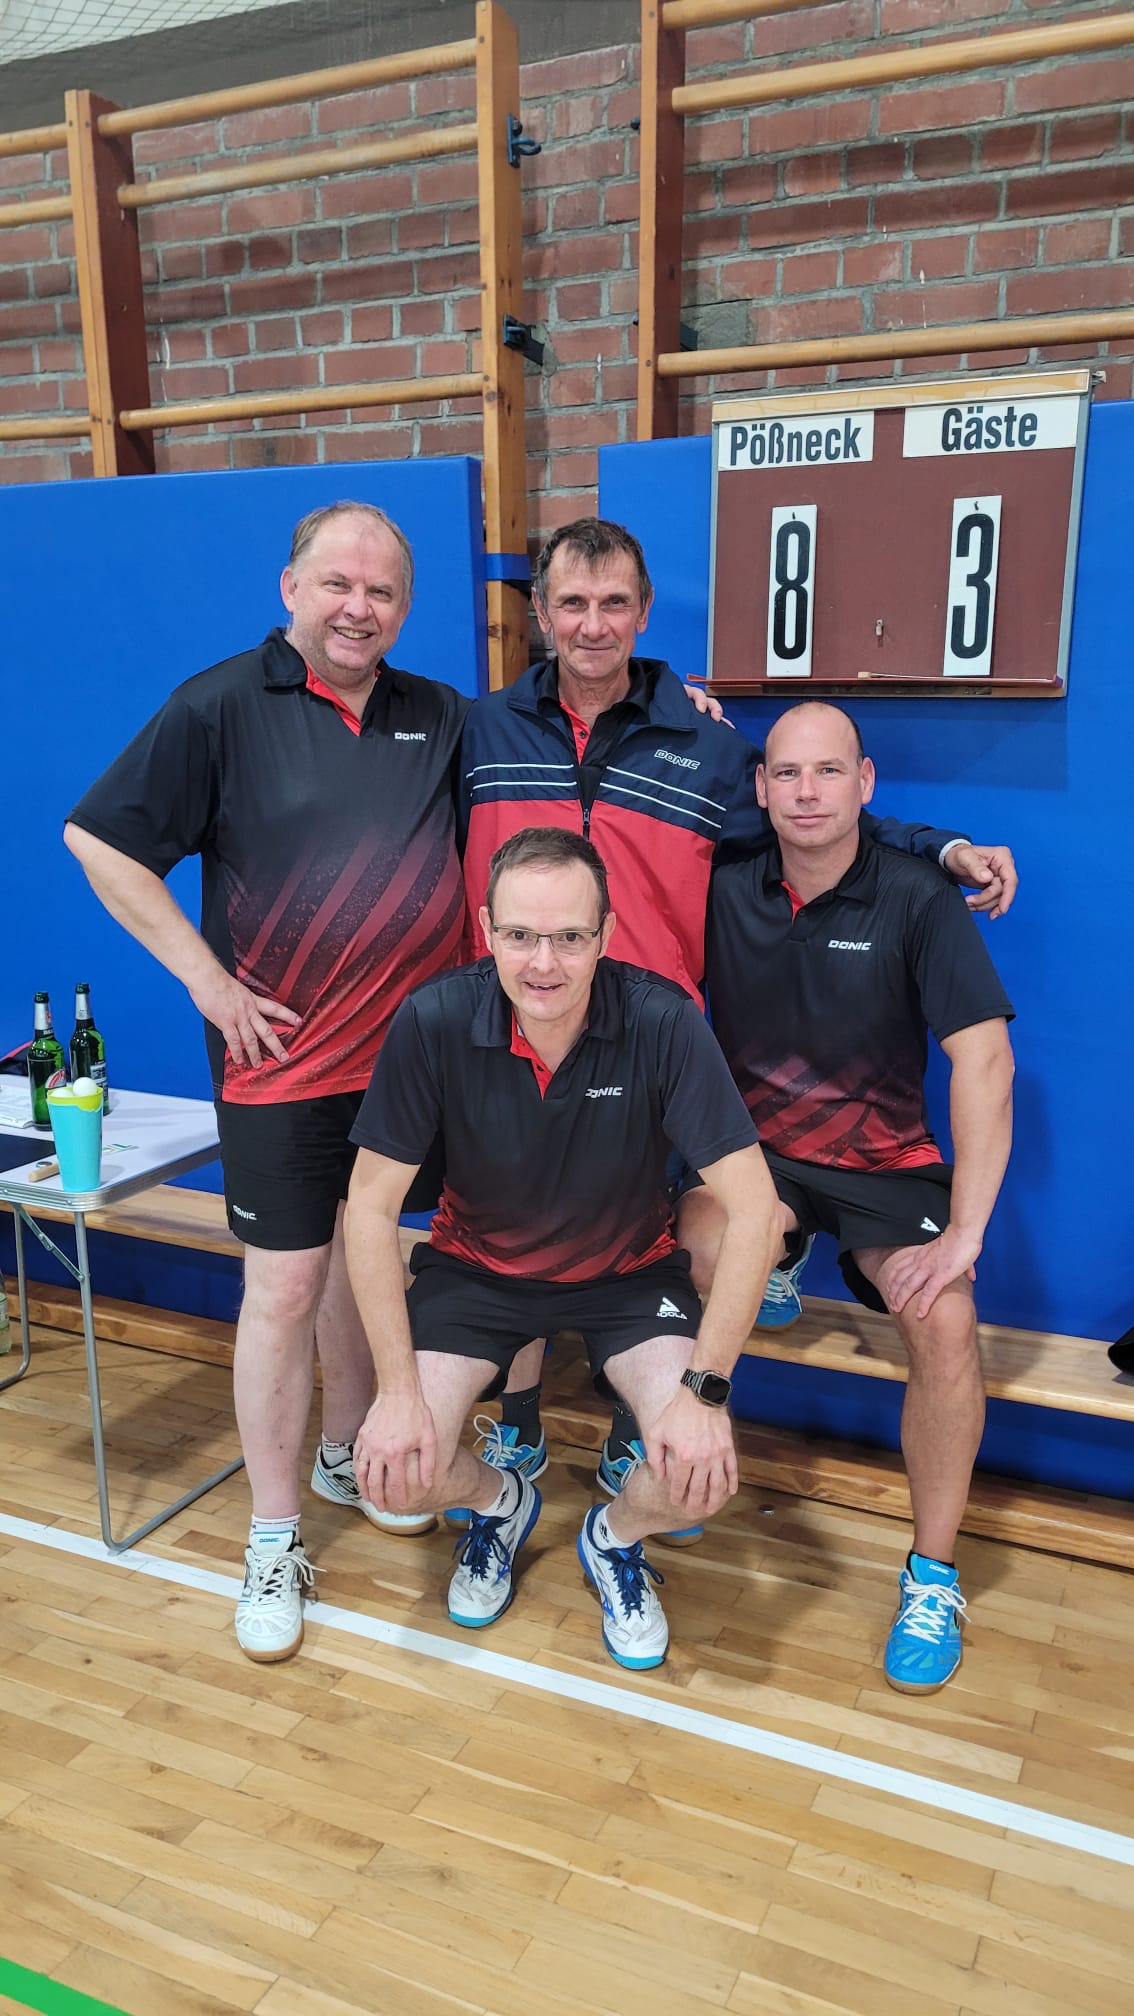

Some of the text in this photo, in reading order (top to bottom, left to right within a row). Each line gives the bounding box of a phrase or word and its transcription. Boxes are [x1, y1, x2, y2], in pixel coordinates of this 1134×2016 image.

[729, 418, 862, 466] Pößneck
[941, 406, 1038, 452] Gäste
[773, 520, 811, 660] 8
[950, 513, 995, 659] 3
[395, 732, 426, 741] DONIC
[653, 749, 701, 770] DONIC
[828, 940, 872, 950] DONIC
